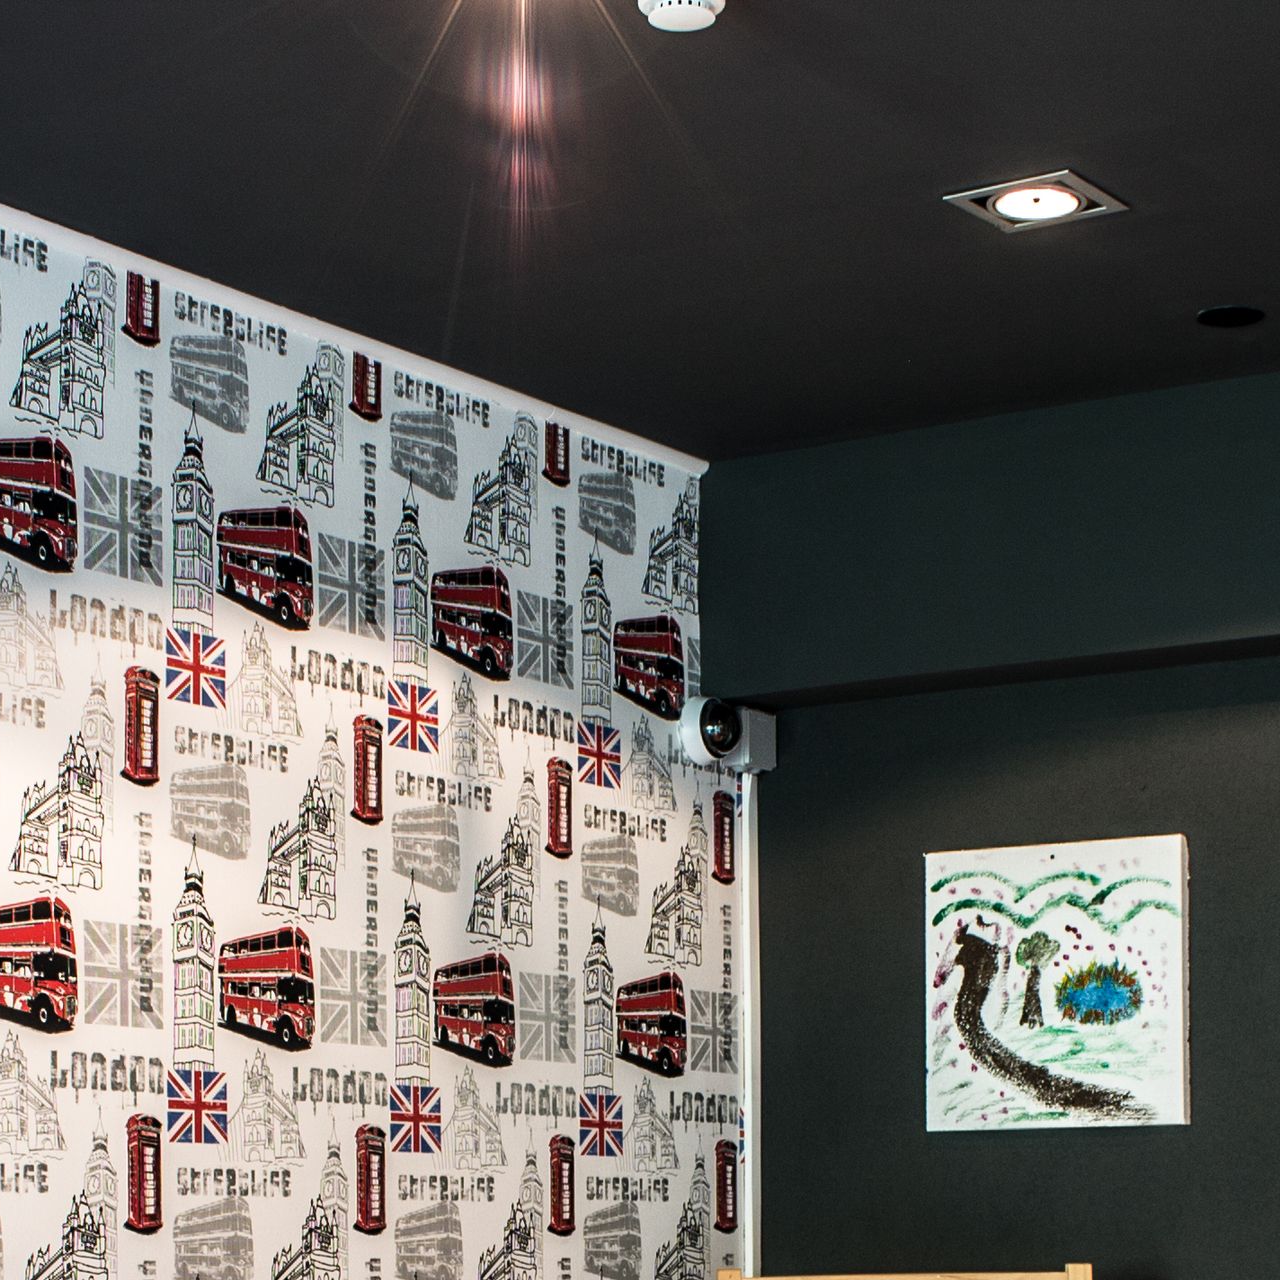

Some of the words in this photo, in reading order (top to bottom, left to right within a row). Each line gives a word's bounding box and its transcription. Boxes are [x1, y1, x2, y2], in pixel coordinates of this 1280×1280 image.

[49, 588, 163, 651] London
[289, 645, 385, 701] London
[492, 693, 575, 743] London
[50, 1050, 164, 1094] London
[291, 1067, 387, 1107] London
[494, 1080, 577, 1117] London
